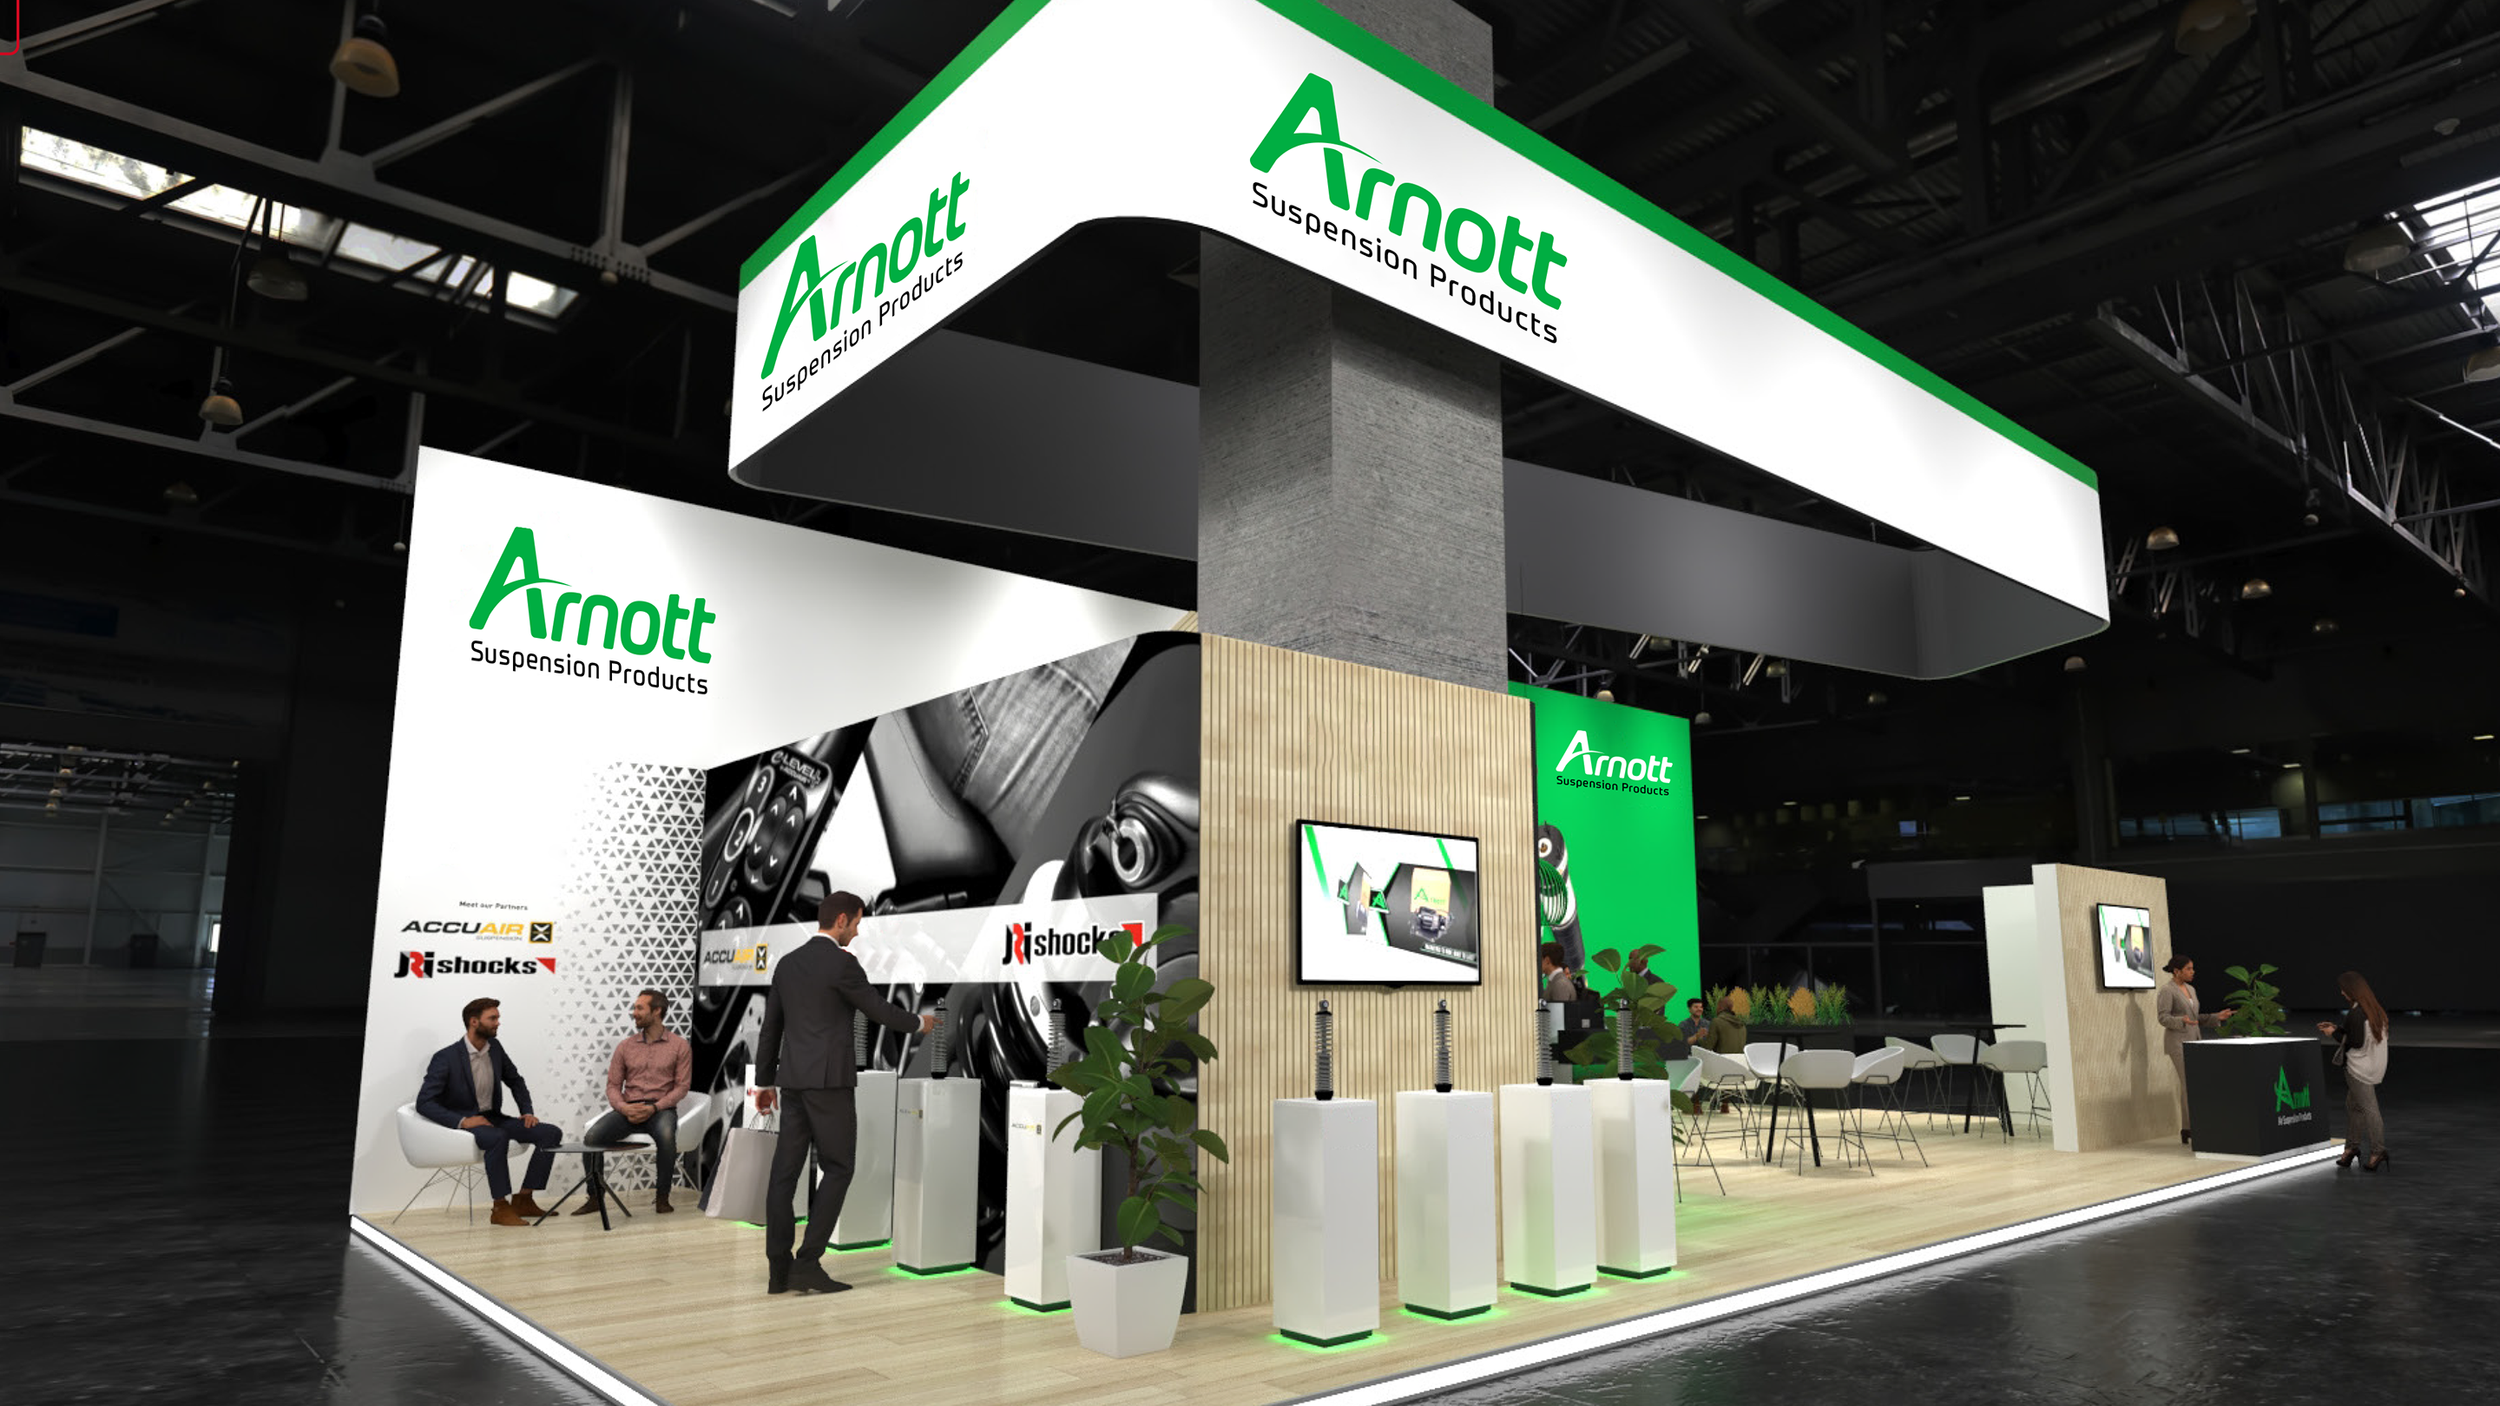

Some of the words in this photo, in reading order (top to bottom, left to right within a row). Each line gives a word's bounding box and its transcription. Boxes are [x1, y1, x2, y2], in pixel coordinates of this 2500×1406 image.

[1250, 72, 1567, 310] Arnott
[760, 171, 970, 380] Arnott
[1252, 182, 1418, 280] Suspension
[1430, 263, 1558, 344] Products
[762, 320, 872, 412] Suspension
[879, 251, 963, 327] Products
[469, 527, 717, 665] Arnott
[471, 640, 600, 679] Suspension
[609, 660, 708, 695] Products
[1555, 729, 1673, 784] Arnott
[1556, 775, 1619, 791] Suspension
[1621, 782, 1670, 796] Products
[401, 920, 525, 935] ACCUAIR
[495, 903, 528, 911] Partners
[437, 956, 538, 974] shocks
[704, 948, 755, 964] ACCUAIR
